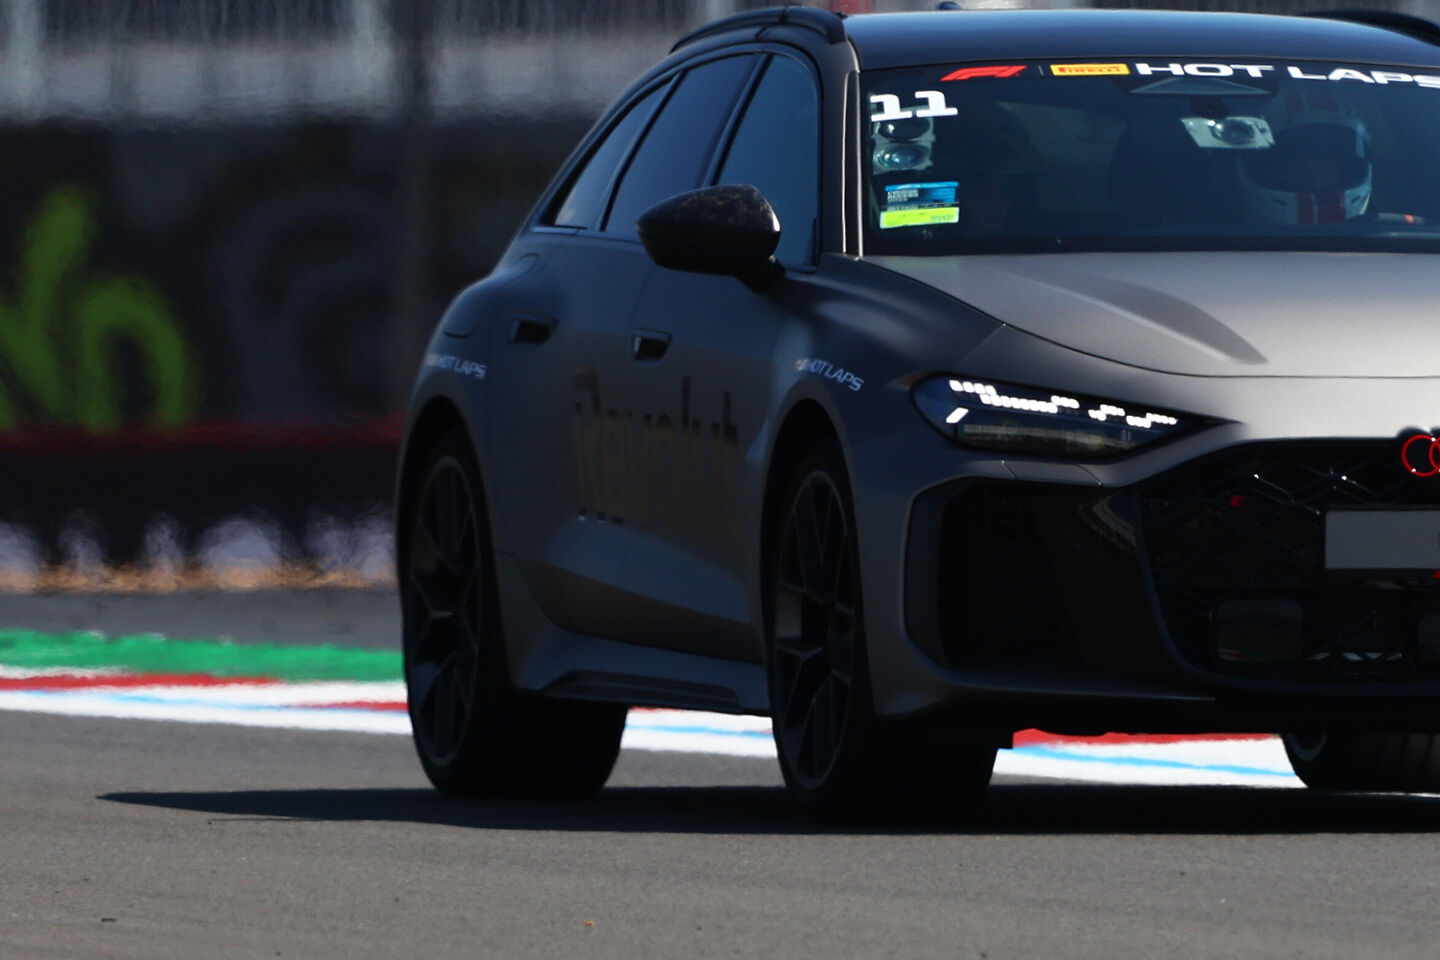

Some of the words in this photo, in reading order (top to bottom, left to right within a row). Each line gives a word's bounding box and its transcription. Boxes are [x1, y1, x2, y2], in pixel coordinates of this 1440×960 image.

[1135, 63, 1275, 78] HOT
[870, 90, 958, 122] 11
[824, 364, 865, 392] LAPS
